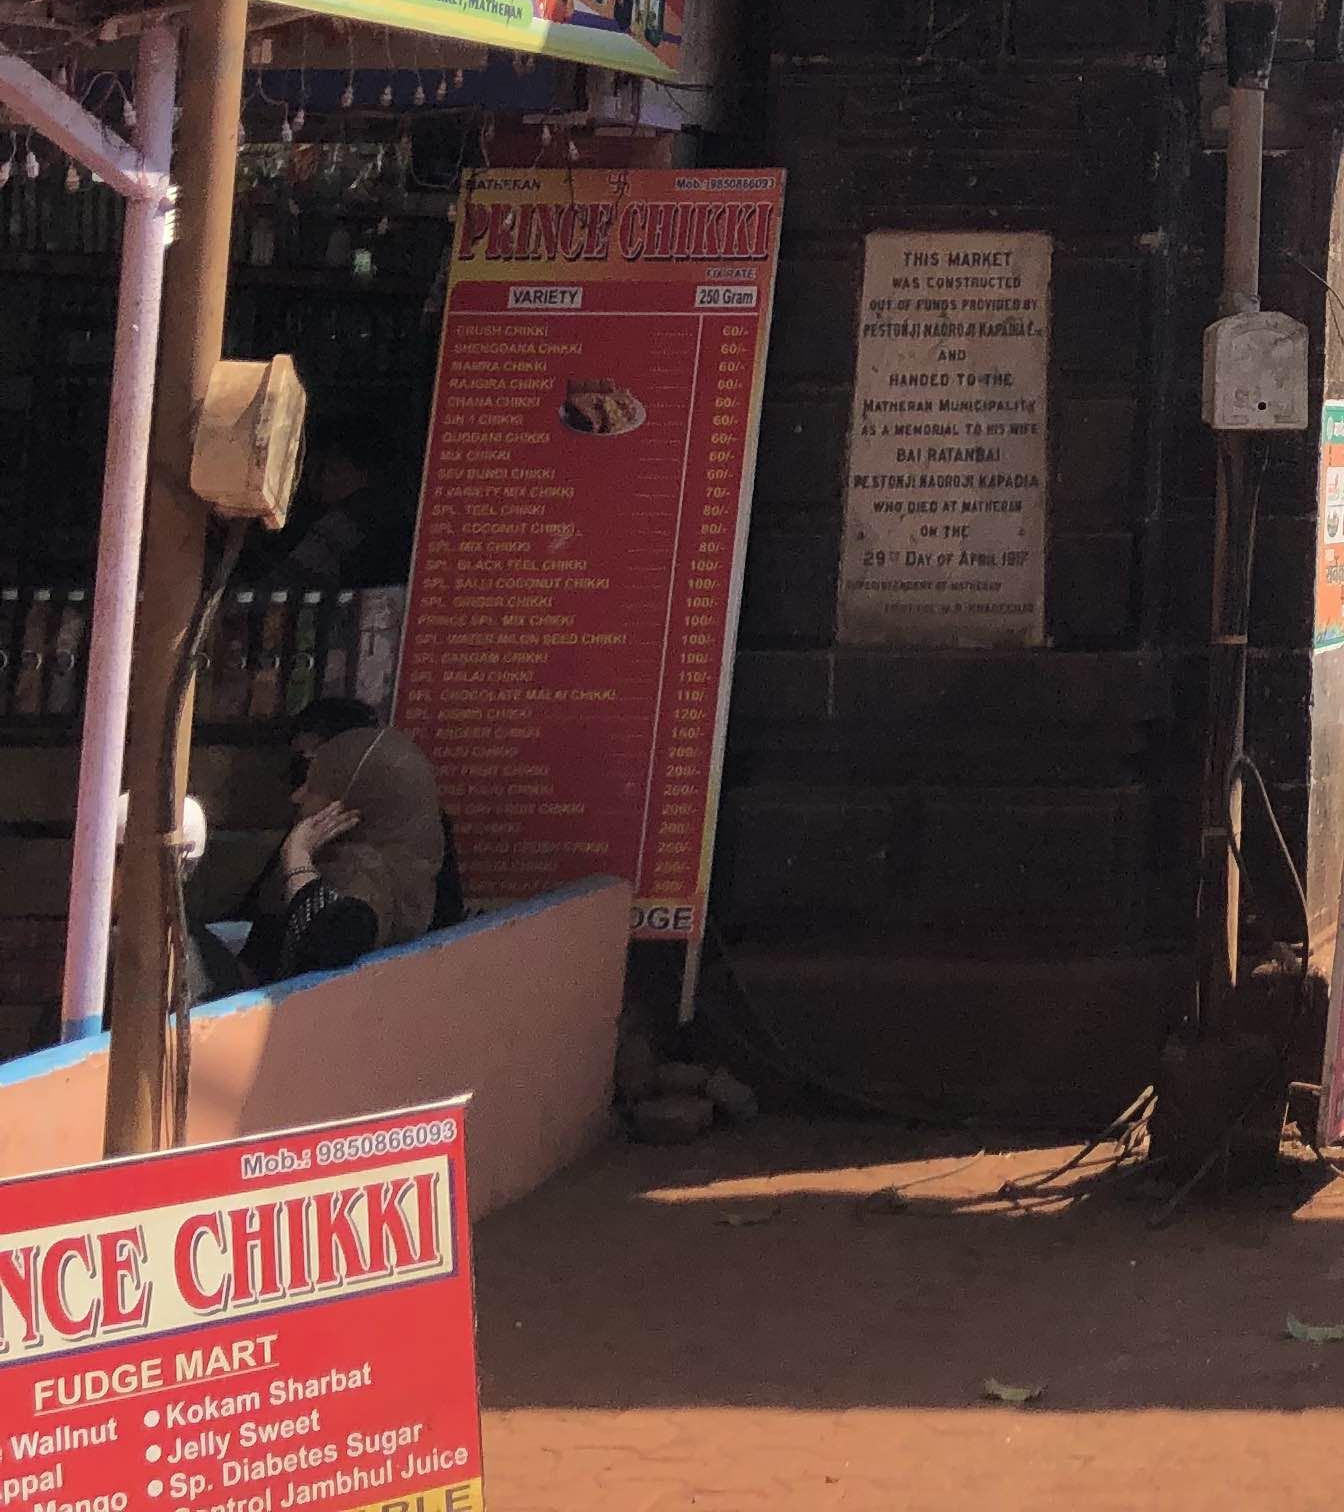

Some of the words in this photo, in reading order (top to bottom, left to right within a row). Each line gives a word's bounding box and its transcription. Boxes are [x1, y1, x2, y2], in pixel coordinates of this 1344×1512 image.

[458, 202, 613, 262] PRINCE
[618, 201, 773, 262] CHIKKI
[904, 252, 939, 267] THIS
[948, 252, 1012, 267] MARKET
[892, 276, 920, 290] WAS
[927, 276, 1021, 290] CONSTRUCTED
[512, 289, 579, 305] VARIETY
[699, 289, 721, 304] 250
[723, 289, 753, 304] Gram
[869, 299, 892, 311] OUT
[898, 299, 911, 311] OF
[916, 299, 957, 311] FUNDS
[961, 299, 1020, 311] PROVIDED
[863, 321, 921, 338] PESTONJI
[937, 349, 967, 361] AND
[889, 373, 949, 386] HANDED
[957, 373, 976, 386] TO
[984, 373, 1014, 386] THE
[861, 423, 876, 436] AS
[881, 423, 890, 436] A
[894, 423, 960, 436] MEMORIAL
[966, 423, 982, 436] TO
[896, 447, 922, 463] BAI
[927, 447, 1001, 463] RATANBAI
[853, 475, 916, 488] PESTONJI
[979, 475, 1040, 488] KAPADIA
[873, 501, 902, 513] WHO
[907, 501, 937, 513] DIED
[942, 501, 957, 513] AT
[920, 525, 937, 538] ON
[943, 525, 969, 538] THE
[242, 1147, 311, 1180] Mob.:
[317, 1119, 458, 1168] 9850866093
[174, 1171, 443, 1317] CHIKKI
[33, 1358, 162, 1412] FUDGE
[175, 1334, 280, 1381] MART
[167, 1390, 261, 1429] Kokam
[269, 1362, 372, 1405] Sharbat
[11, 1418, 118, 1460] Wallnut
[167, 1431, 231, 1466] Jelly
[239, 1409, 321, 1446] Sweet
[170, 1471, 213, 1503] Sp.
[222, 1437, 338, 1487] Diabetes
[346, 1421, 424, 1461] Sugar
[280, 1459, 393, 1508] Jambhul
[402, 1445, 469, 1480] Juice
